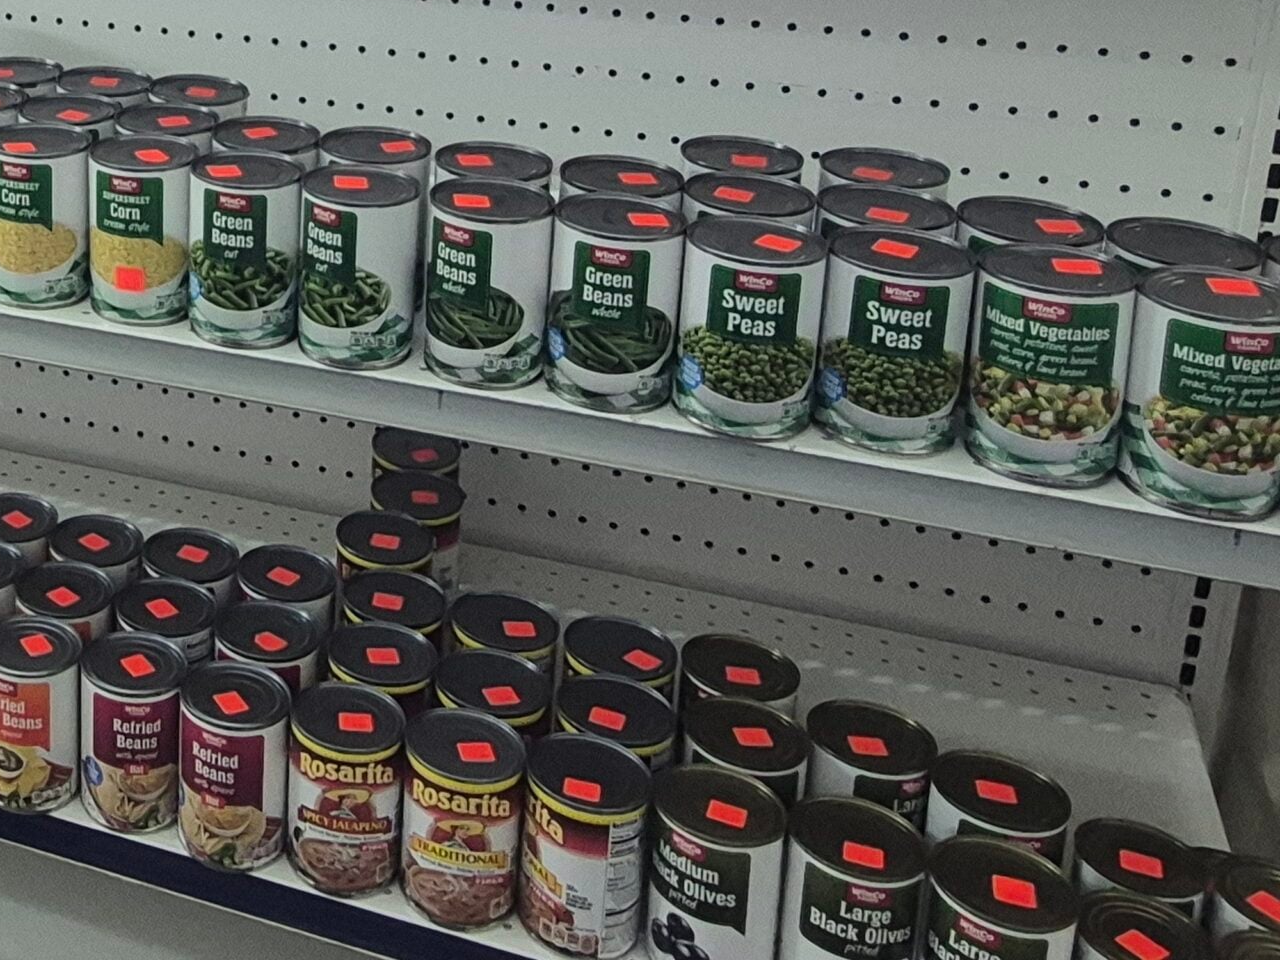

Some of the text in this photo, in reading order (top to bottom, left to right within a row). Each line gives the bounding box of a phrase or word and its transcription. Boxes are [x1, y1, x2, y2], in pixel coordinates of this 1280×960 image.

[1, 189, 31, 206] Corn
[110, 203, 141, 221] Corn
[213, 211, 253, 231] Green
[211, 228, 255, 249] Beans
[308, 221, 342, 247] Green
[224, 249, 240, 259] cut
[307, 238, 343, 265] Beans
[437, 241, 476, 268] Green
[436, 258, 477, 286] Beans
[585, 266, 633, 289] Green
[738, 274, 773, 287] WinCo
[582, 284, 633, 307] Beans
[722, 288, 786, 315] Sweet
[884, 285, 921, 300] WinCo
[866, 300, 933, 328] Sweet
[1027, 301, 1066, 316] WinCo
[727, 312, 776, 337] Peas
[985, 305, 1111, 342] Mixed Vegetables
[871, 324, 923, 350] Peas
[1230, 334, 1270, 348] WinCo
[1172, 342, 1225, 369] Mixed
[2, 711, 43, 730] Beans
[113, 717, 162, 734] Refried
[116, 734, 158, 750] Beans
[192, 741, 239, 769] Refried
[195, 758, 235, 784] Beans
[659, 840, 720, 886] Medium
[683, 878, 737, 908] Olives
[839, 900, 892, 926] Large
[809, 906, 912, 946] Black Olives
